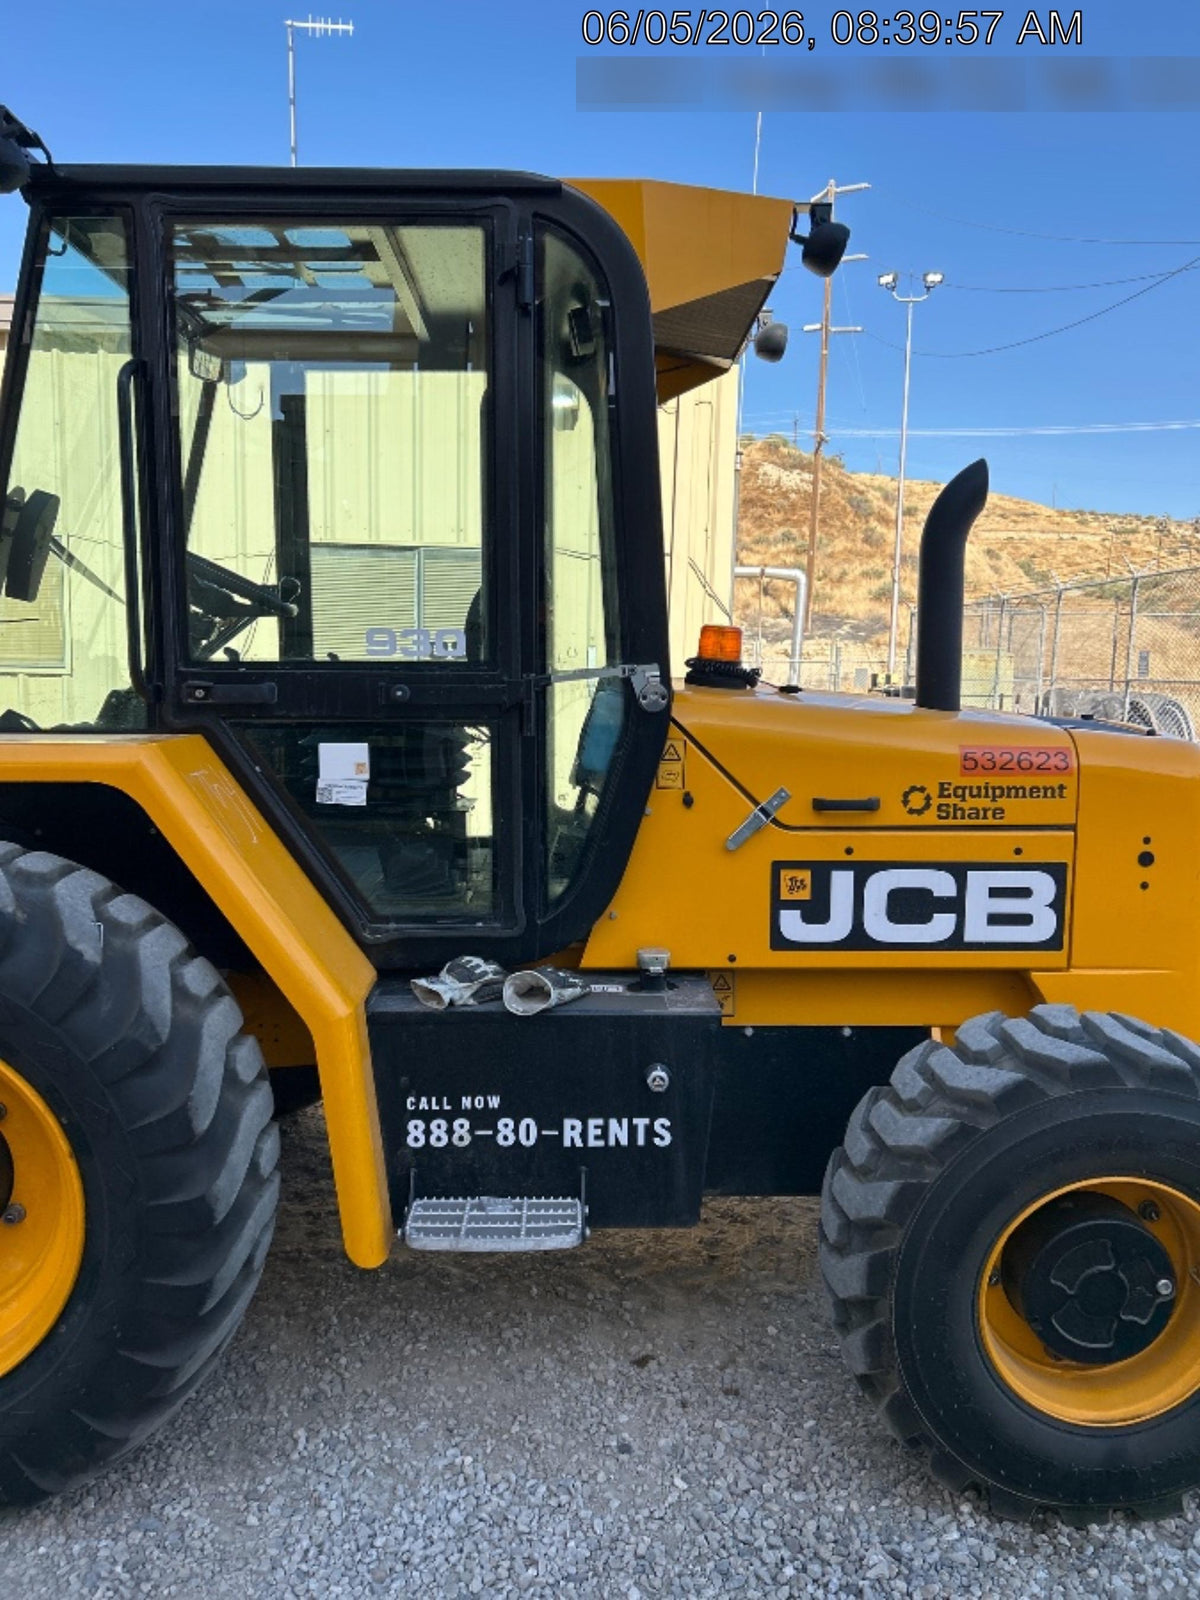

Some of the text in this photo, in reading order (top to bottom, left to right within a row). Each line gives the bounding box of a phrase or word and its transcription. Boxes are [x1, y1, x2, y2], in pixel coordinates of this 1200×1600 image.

[365, 627, 467, 657] 930
[962, 751, 1070, 771] 532623
[937, 781, 1067, 803] Equipment
[936, 803, 1006, 820] Share
[779, 868, 1058, 944] JCB
[406, 1095, 501, 1111] CALL NOW
[406, 1117, 673, 1149] 888-80-RENTS
